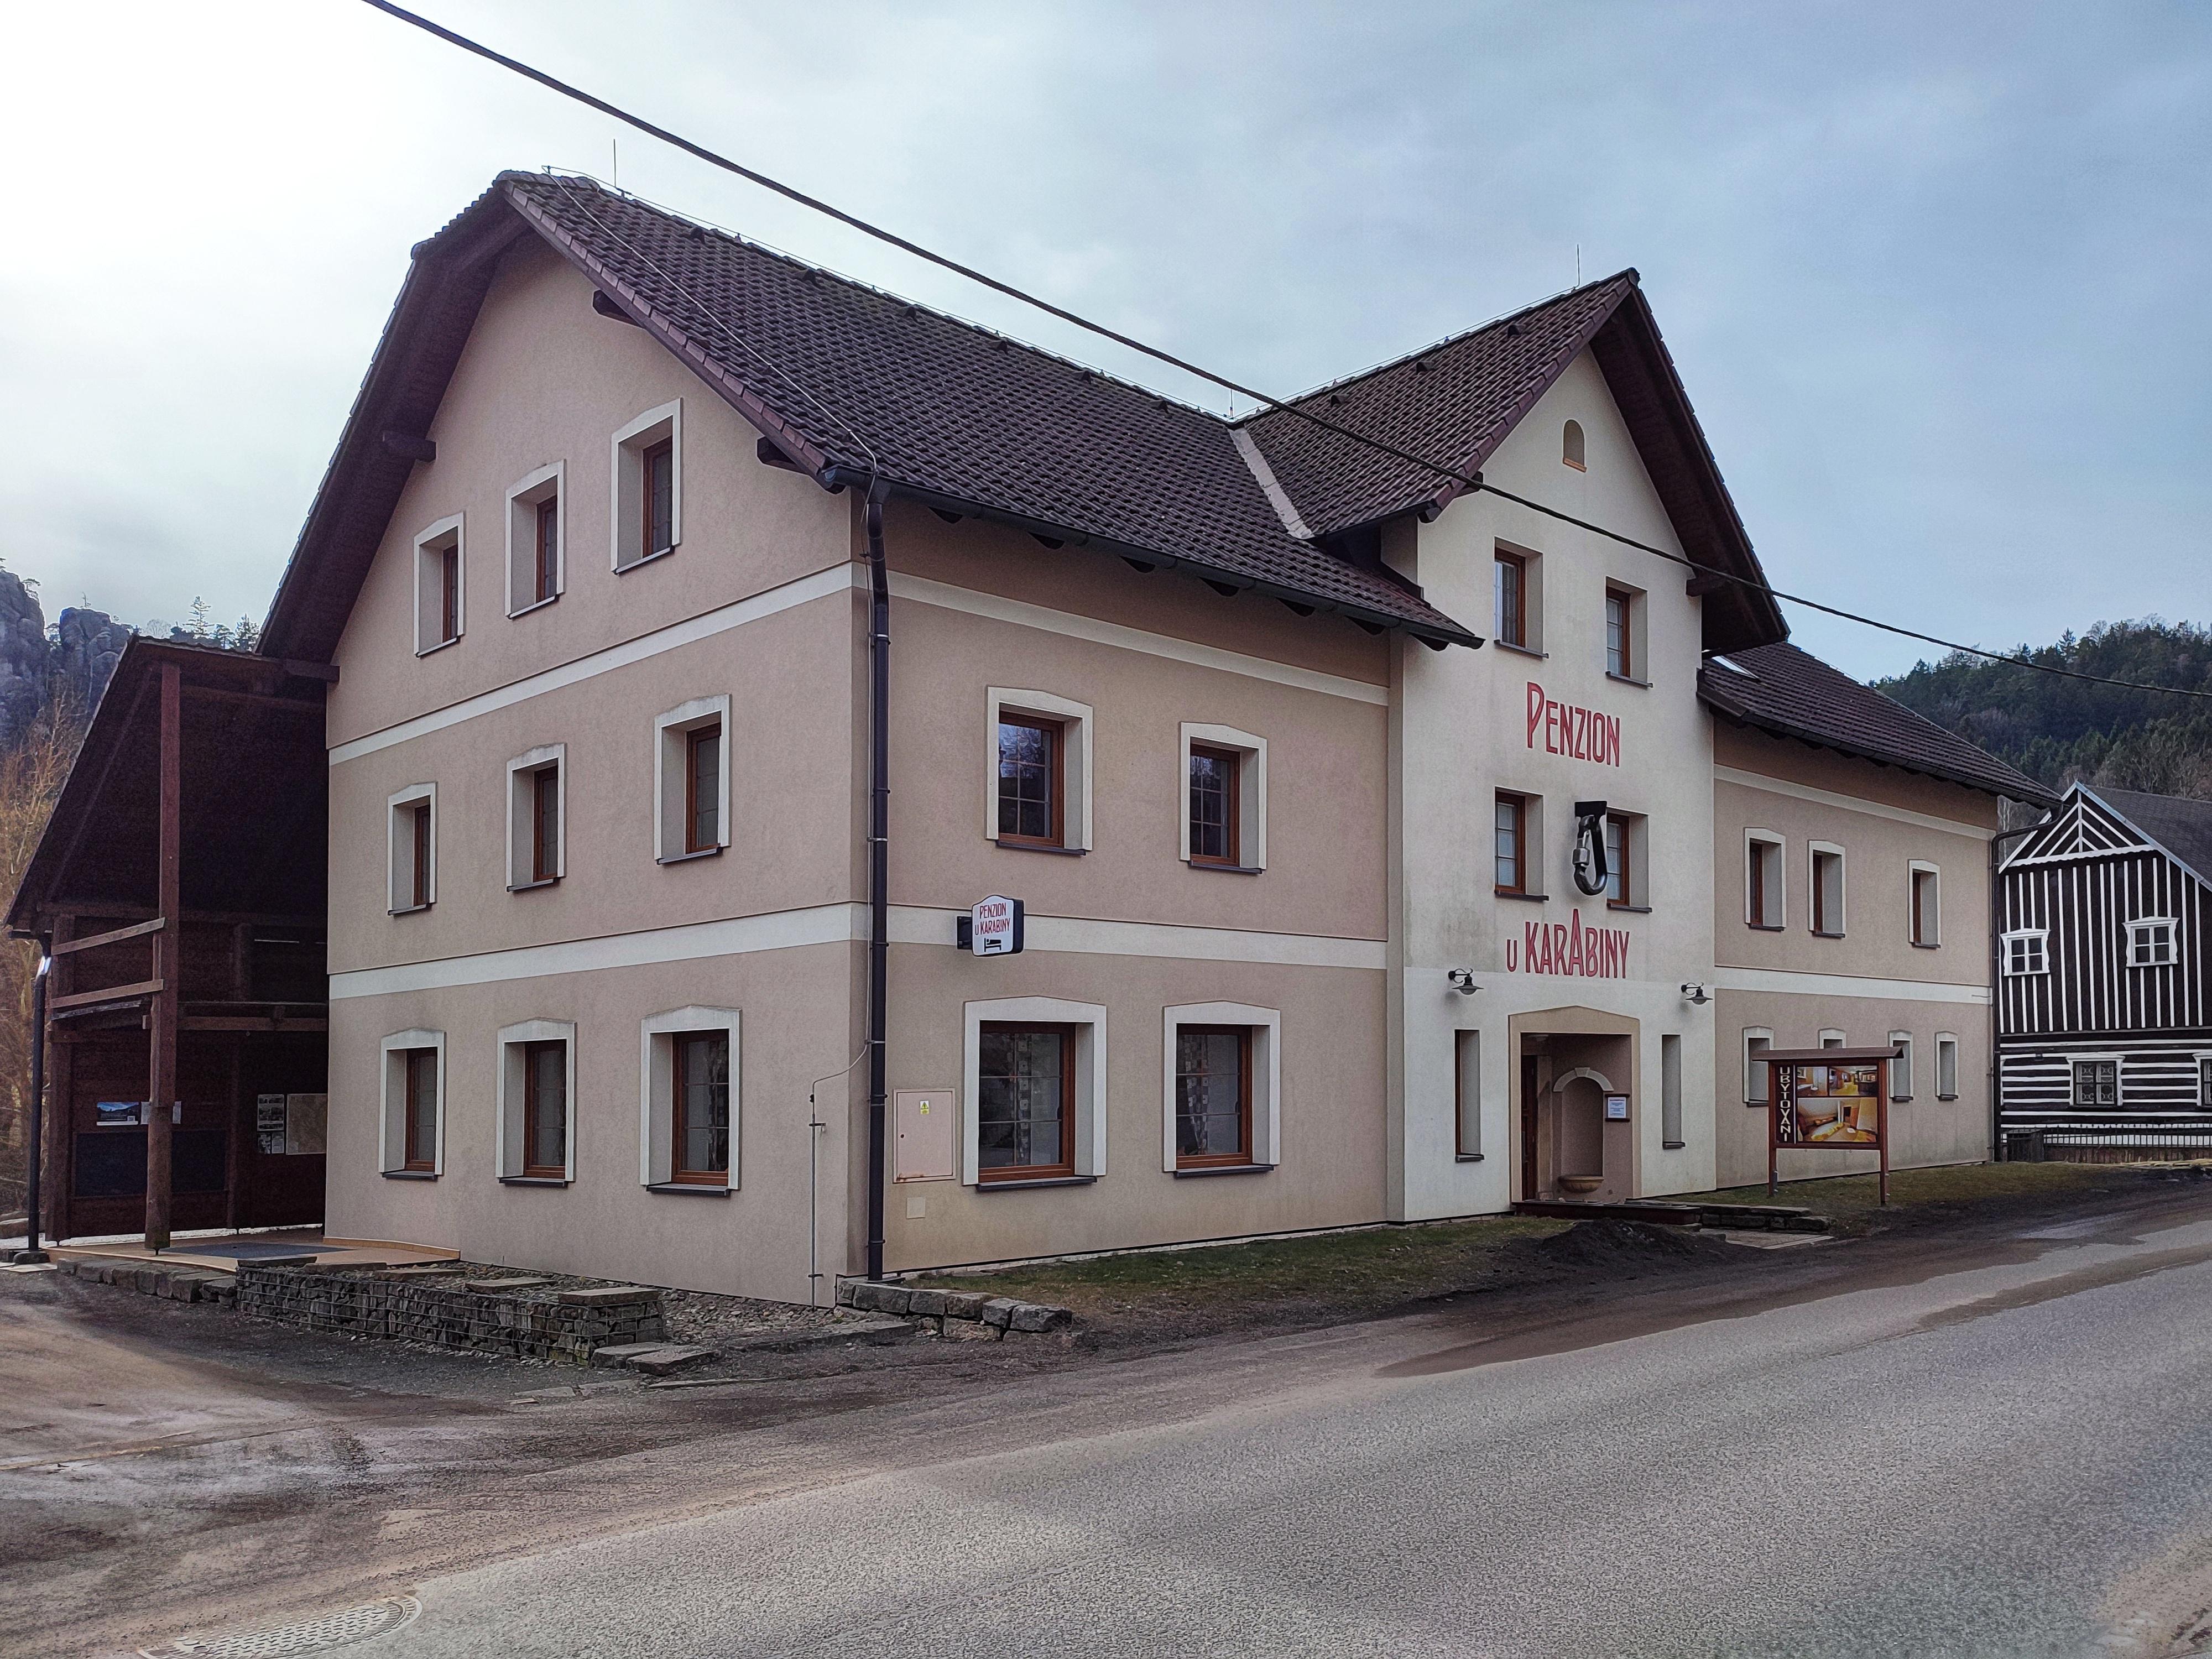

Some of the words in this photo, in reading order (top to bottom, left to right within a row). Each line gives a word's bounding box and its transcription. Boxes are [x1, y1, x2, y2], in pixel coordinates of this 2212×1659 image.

[1527, 681, 1620, 768] PENZION
[980, 903, 1006, 919] PENZION
[980, 918, 1010, 935] KARABINY
[1525, 908, 1630, 979] KARABINY
